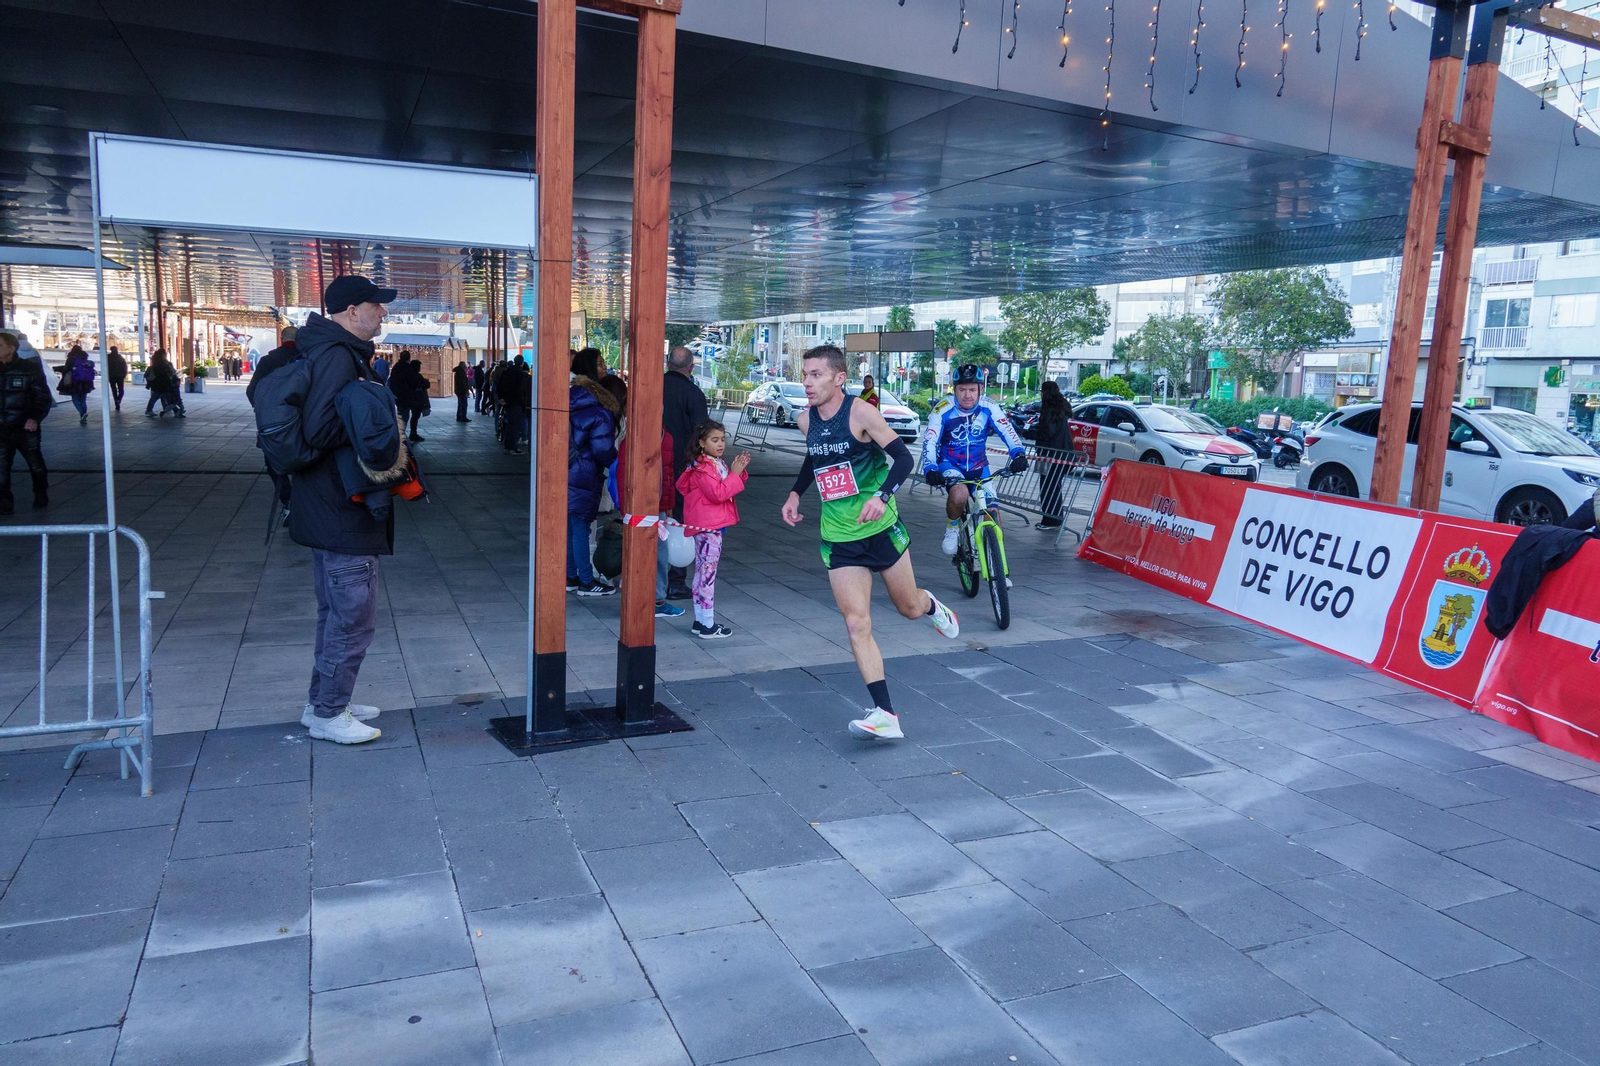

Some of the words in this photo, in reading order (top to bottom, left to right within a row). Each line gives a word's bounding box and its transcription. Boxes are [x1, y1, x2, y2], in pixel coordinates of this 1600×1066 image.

[829, 441, 850, 454] auga
[824, 473, 847, 489] 592
[1154, 515, 1167, 534] de
[1168, 522, 1195, 545] xogo
[1241, 516, 1391, 580] CONCELLO
[1140, 560, 1159, 573] MELLOR
[1159, 567, 1178, 579] CIDADE
[1177, 573, 1191, 585] PARA
[1192, 578, 1208, 590] VIVIR
[1240, 558, 1279, 595] DE
[1285, 569, 1355, 619] VIGO
[1491, 700, 1518, 715] vigo.org
